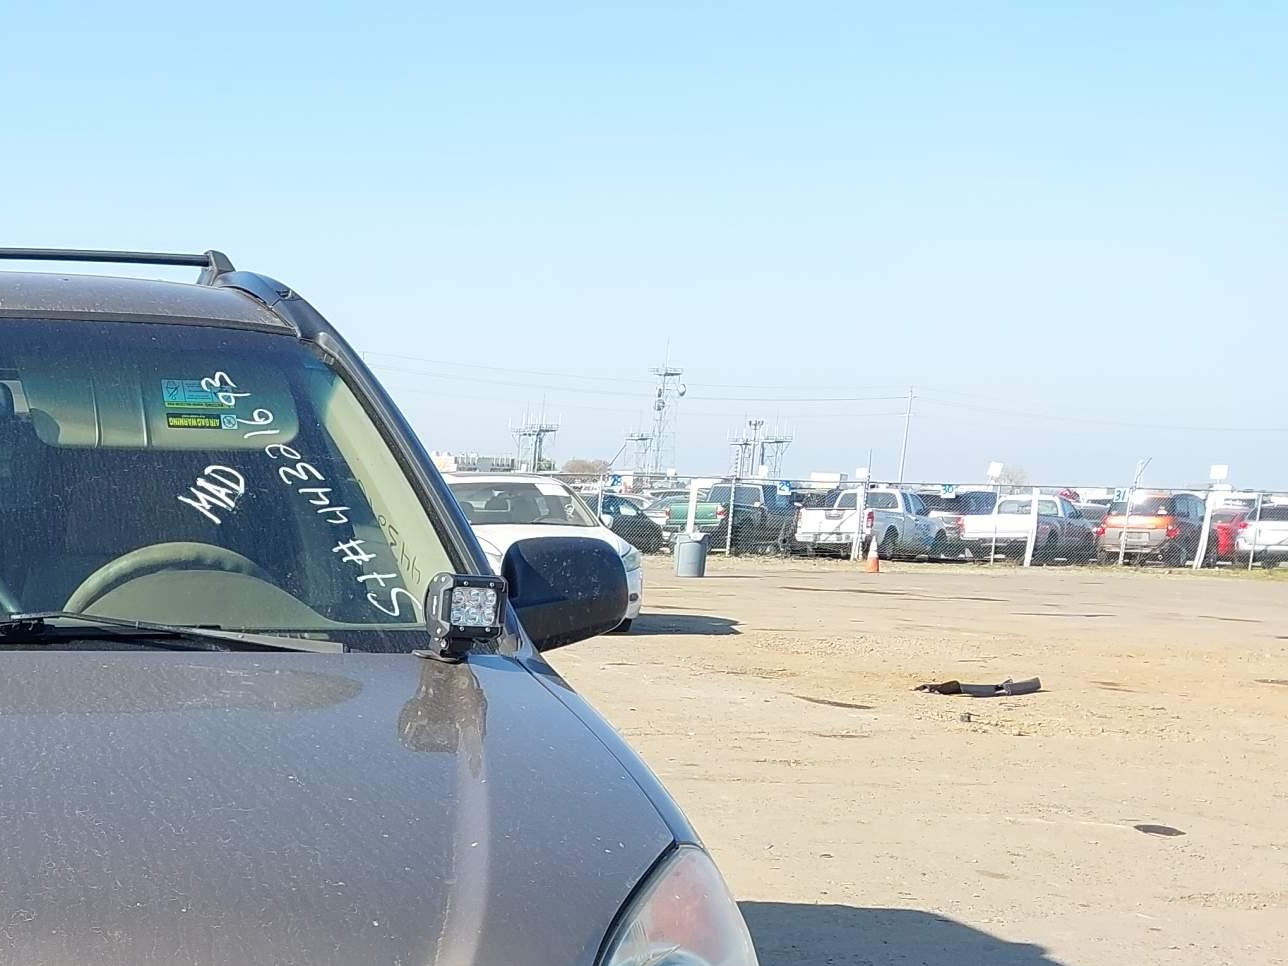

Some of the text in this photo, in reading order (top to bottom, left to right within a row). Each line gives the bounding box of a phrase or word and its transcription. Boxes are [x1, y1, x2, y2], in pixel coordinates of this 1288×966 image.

[779, 480, 792, 492] 29
[177, 465, 245, 524] MAD
[1114, 488, 1127, 502] 31
